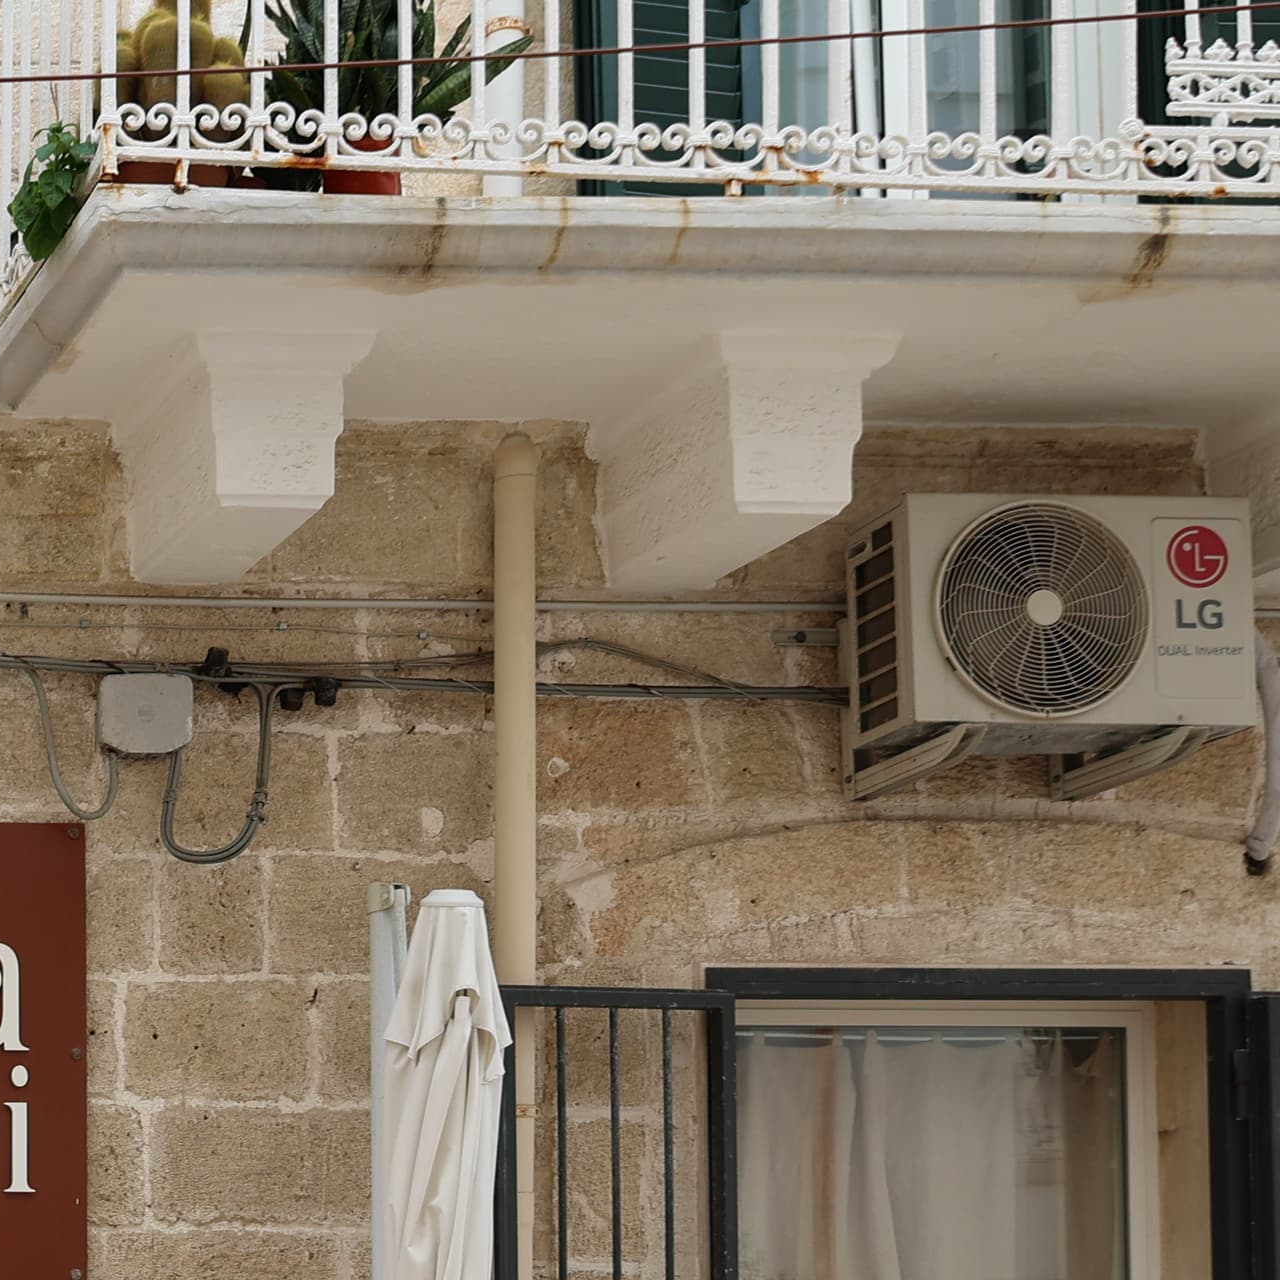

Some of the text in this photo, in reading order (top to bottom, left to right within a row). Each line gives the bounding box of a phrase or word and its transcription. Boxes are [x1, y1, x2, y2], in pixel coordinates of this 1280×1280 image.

[1175, 599, 1223, 629] LG
[1157, 645, 1243, 656] DUAL Inverter
